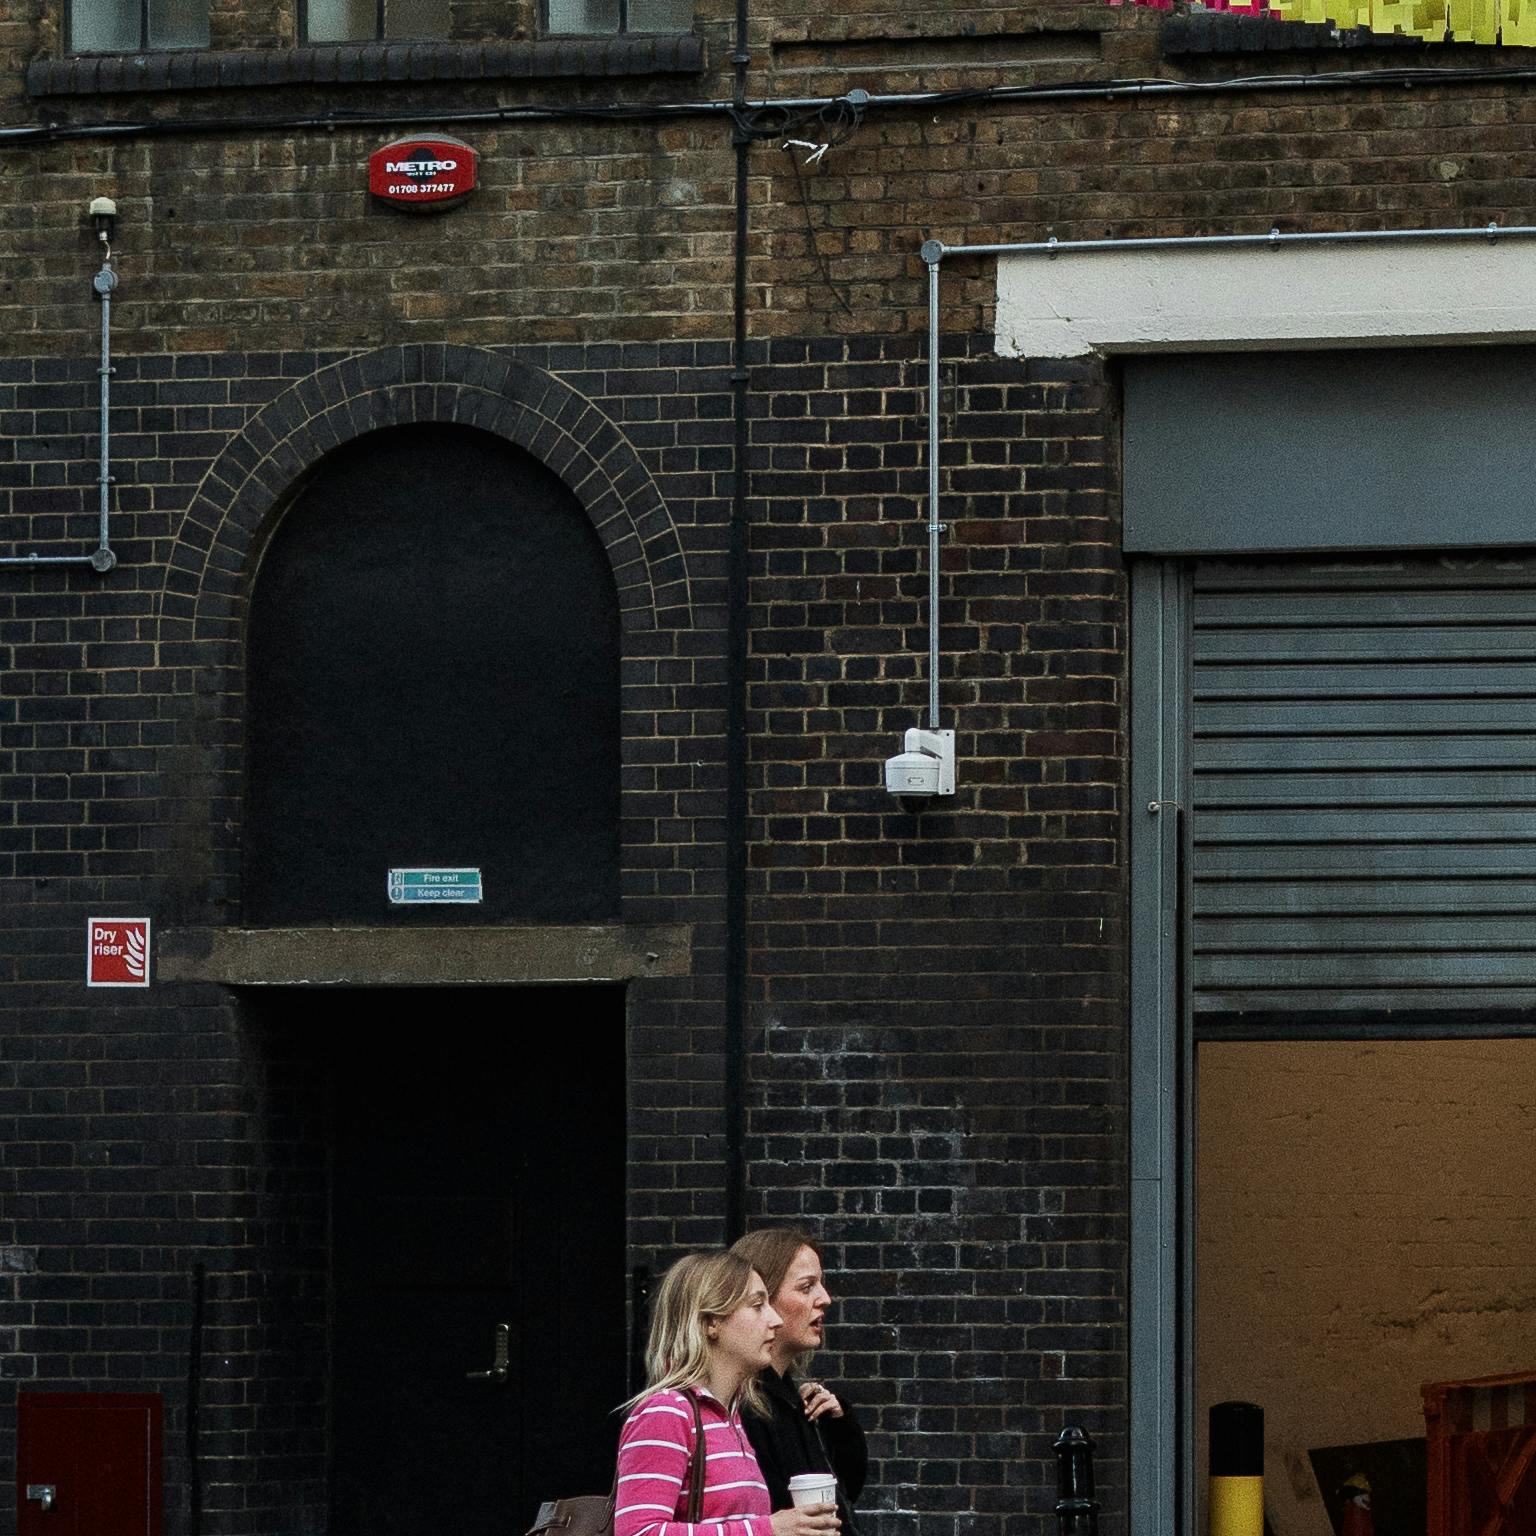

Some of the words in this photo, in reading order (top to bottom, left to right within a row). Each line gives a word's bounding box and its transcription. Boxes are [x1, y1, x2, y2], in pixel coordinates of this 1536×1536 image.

[386, 161, 457, 172] METRO
[420, 184, 455, 193] 377477
[424, 874, 440, 882] Fire
[442, 874, 458, 882] exit
[417, 889, 440, 898] Keep
[442, 889, 464, 897] clear
[94, 928, 117, 944] Dry
[94, 943, 123, 956] riser
